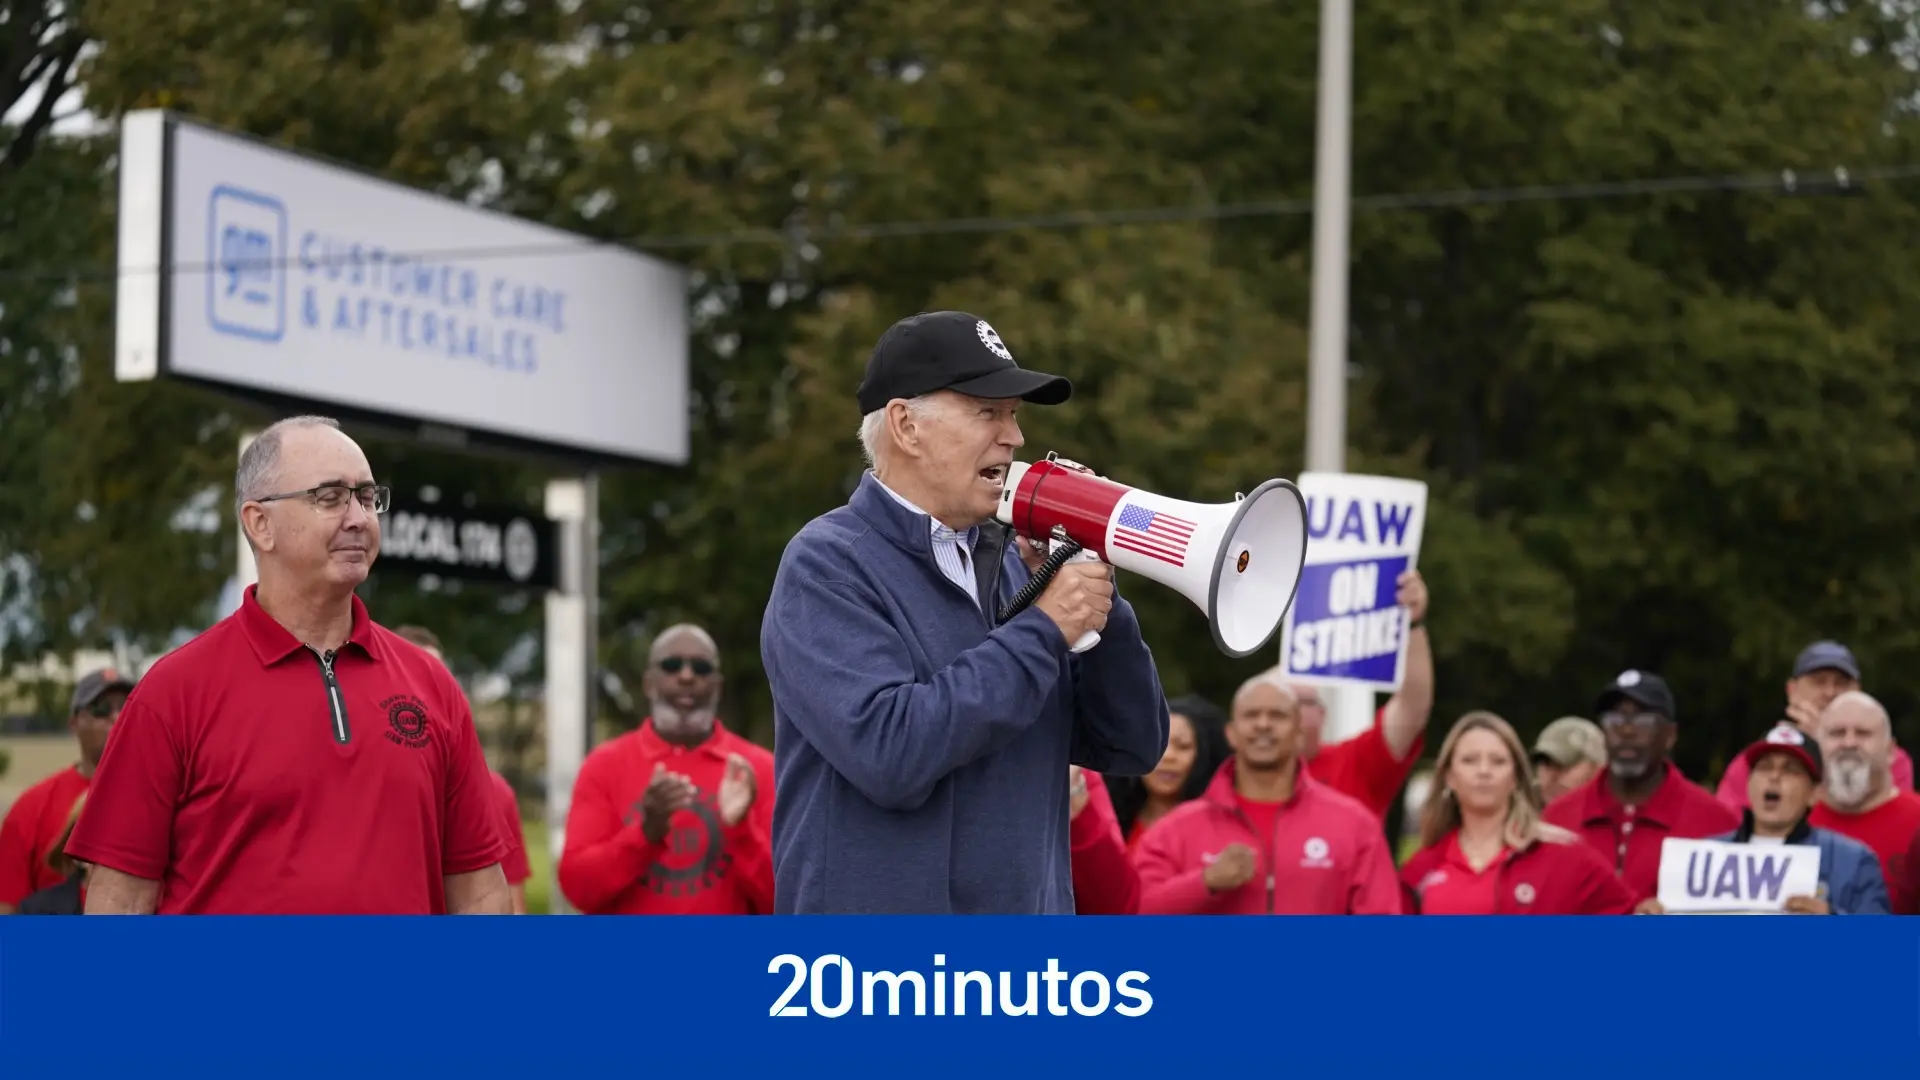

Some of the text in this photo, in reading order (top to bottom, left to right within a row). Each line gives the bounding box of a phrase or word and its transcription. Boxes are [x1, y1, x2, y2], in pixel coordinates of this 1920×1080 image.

[301, 232, 568, 332] CUSTOMER CARE
[302, 289, 538, 373] & AFTERSALES
[381, 510, 459, 565] LOCAL
[1308, 497, 1413, 545] UAW
[1328, 561, 1379, 616] ON
[1290, 605, 1404, 672] STRIKE
[1687, 850, 1793, 902] UAW
